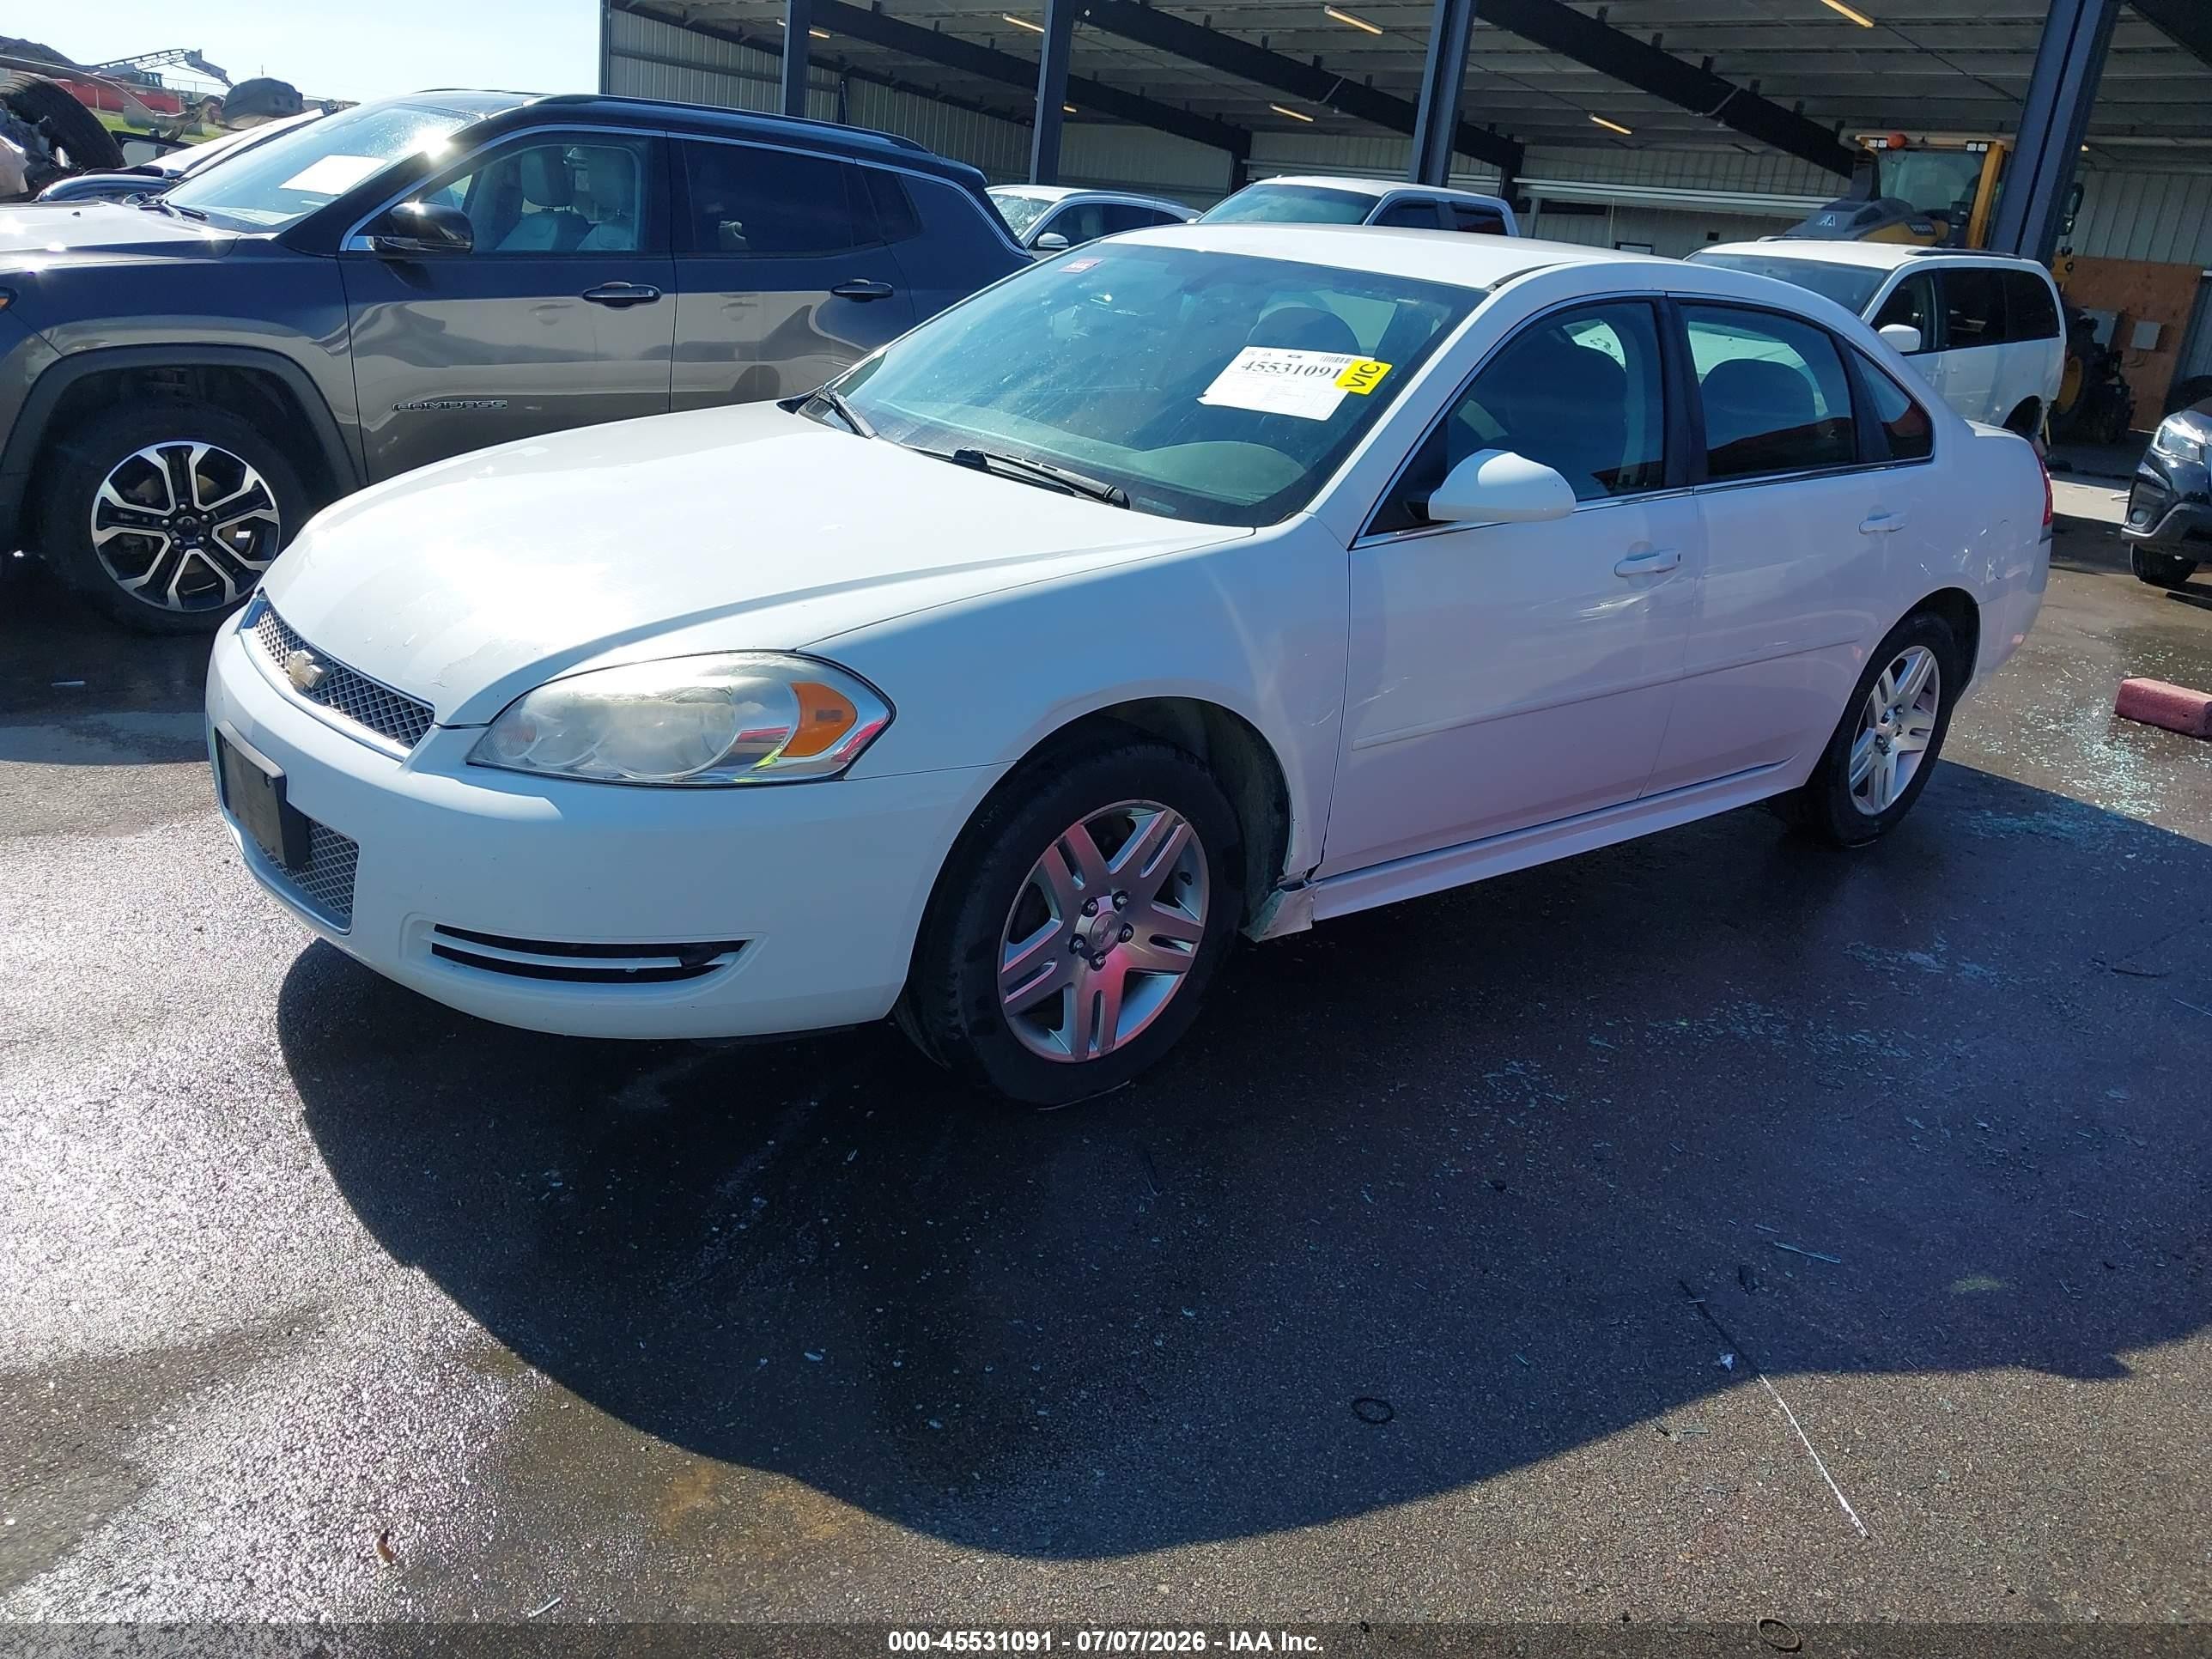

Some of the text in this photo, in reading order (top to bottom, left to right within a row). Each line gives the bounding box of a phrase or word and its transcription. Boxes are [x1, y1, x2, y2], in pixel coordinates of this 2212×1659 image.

[1241, 360, 1343, 379] 45531091
[1343, 362, 1381, 387] VIC
[392, 399, 508, 412] COMPASS
